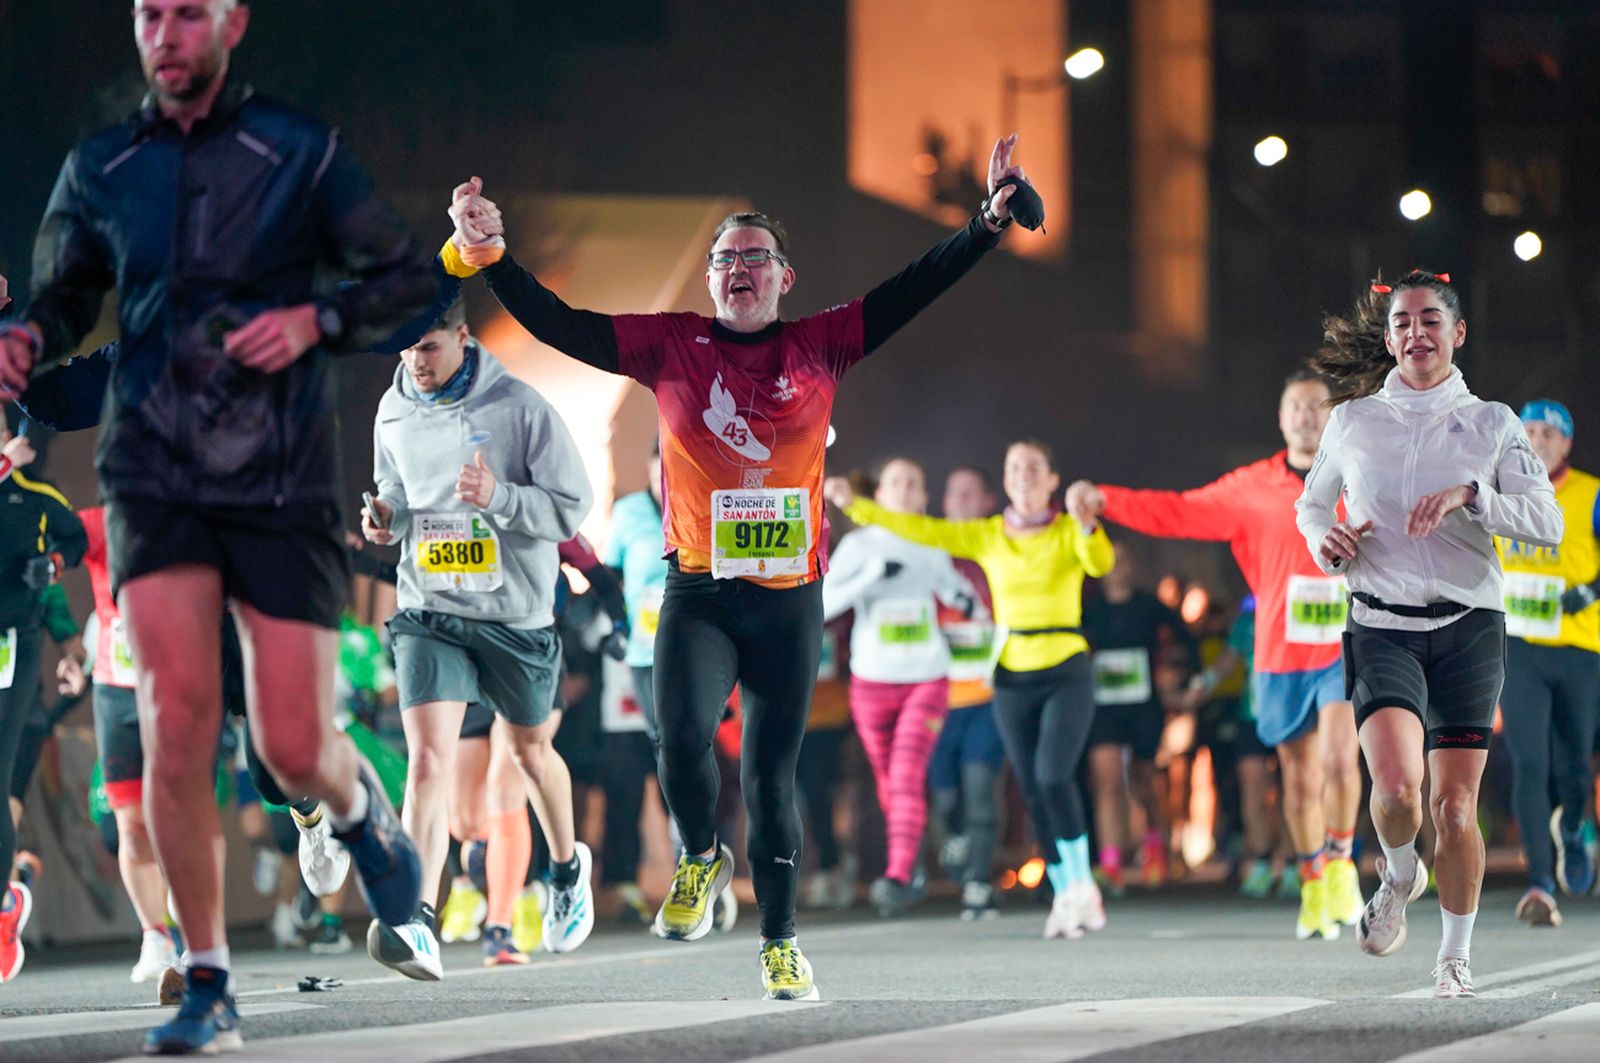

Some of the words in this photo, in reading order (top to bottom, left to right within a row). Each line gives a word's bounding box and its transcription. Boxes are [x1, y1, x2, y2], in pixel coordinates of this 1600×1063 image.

[722, 422, 748, 446] 43
[723, 511, 743, 520] SAN
[734, 499, 763, 508] NOCHE
[765, 499, 776, 508] DE
[735, 521, 790, 549] 9172
[429, 541, 484, 565] 5380
